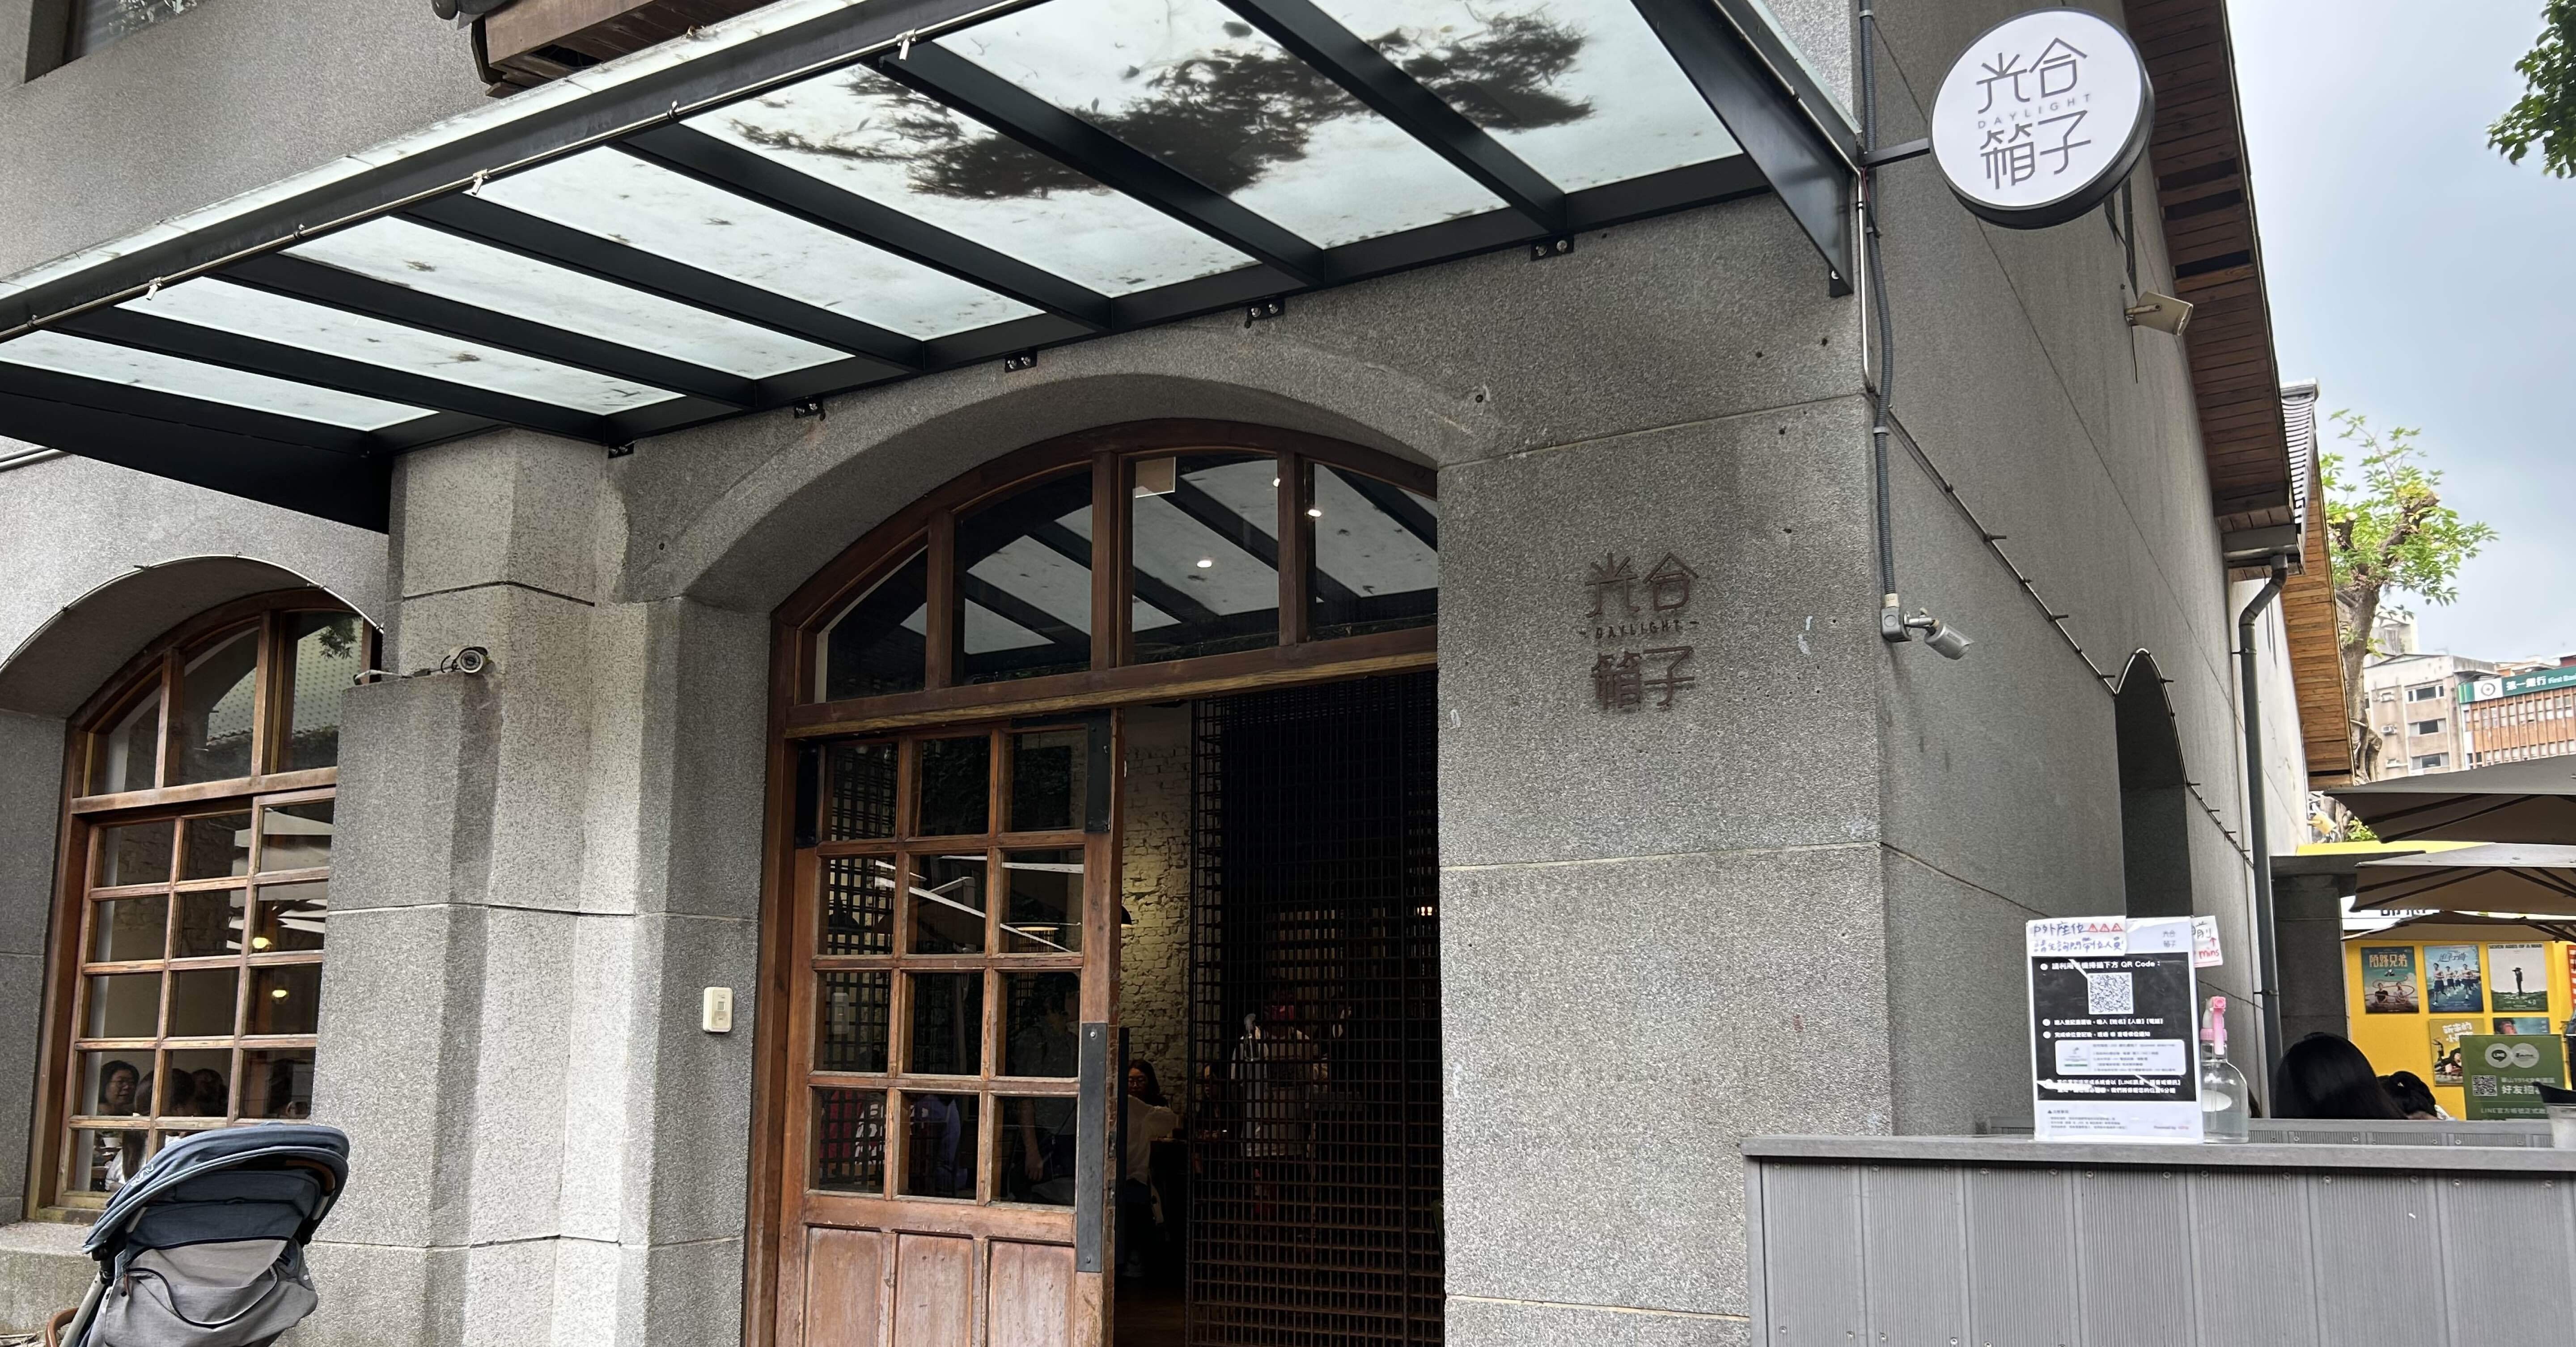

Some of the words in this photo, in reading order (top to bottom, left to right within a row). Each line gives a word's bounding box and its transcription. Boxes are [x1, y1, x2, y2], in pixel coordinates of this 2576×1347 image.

[1976, 37, 2088, 114] 光合
[1978, 93, 2092, 129] DAYLIGHT
[1979, 110, 2092, 190] 箱子
[1584, 552, 1699, 618] 光合
[1595, 618, 1683, 639] DAYLIGHT
[1590, 645, 1695, 710] 箱子
[2369, 953, 2408, 968] 陌路兄弟
